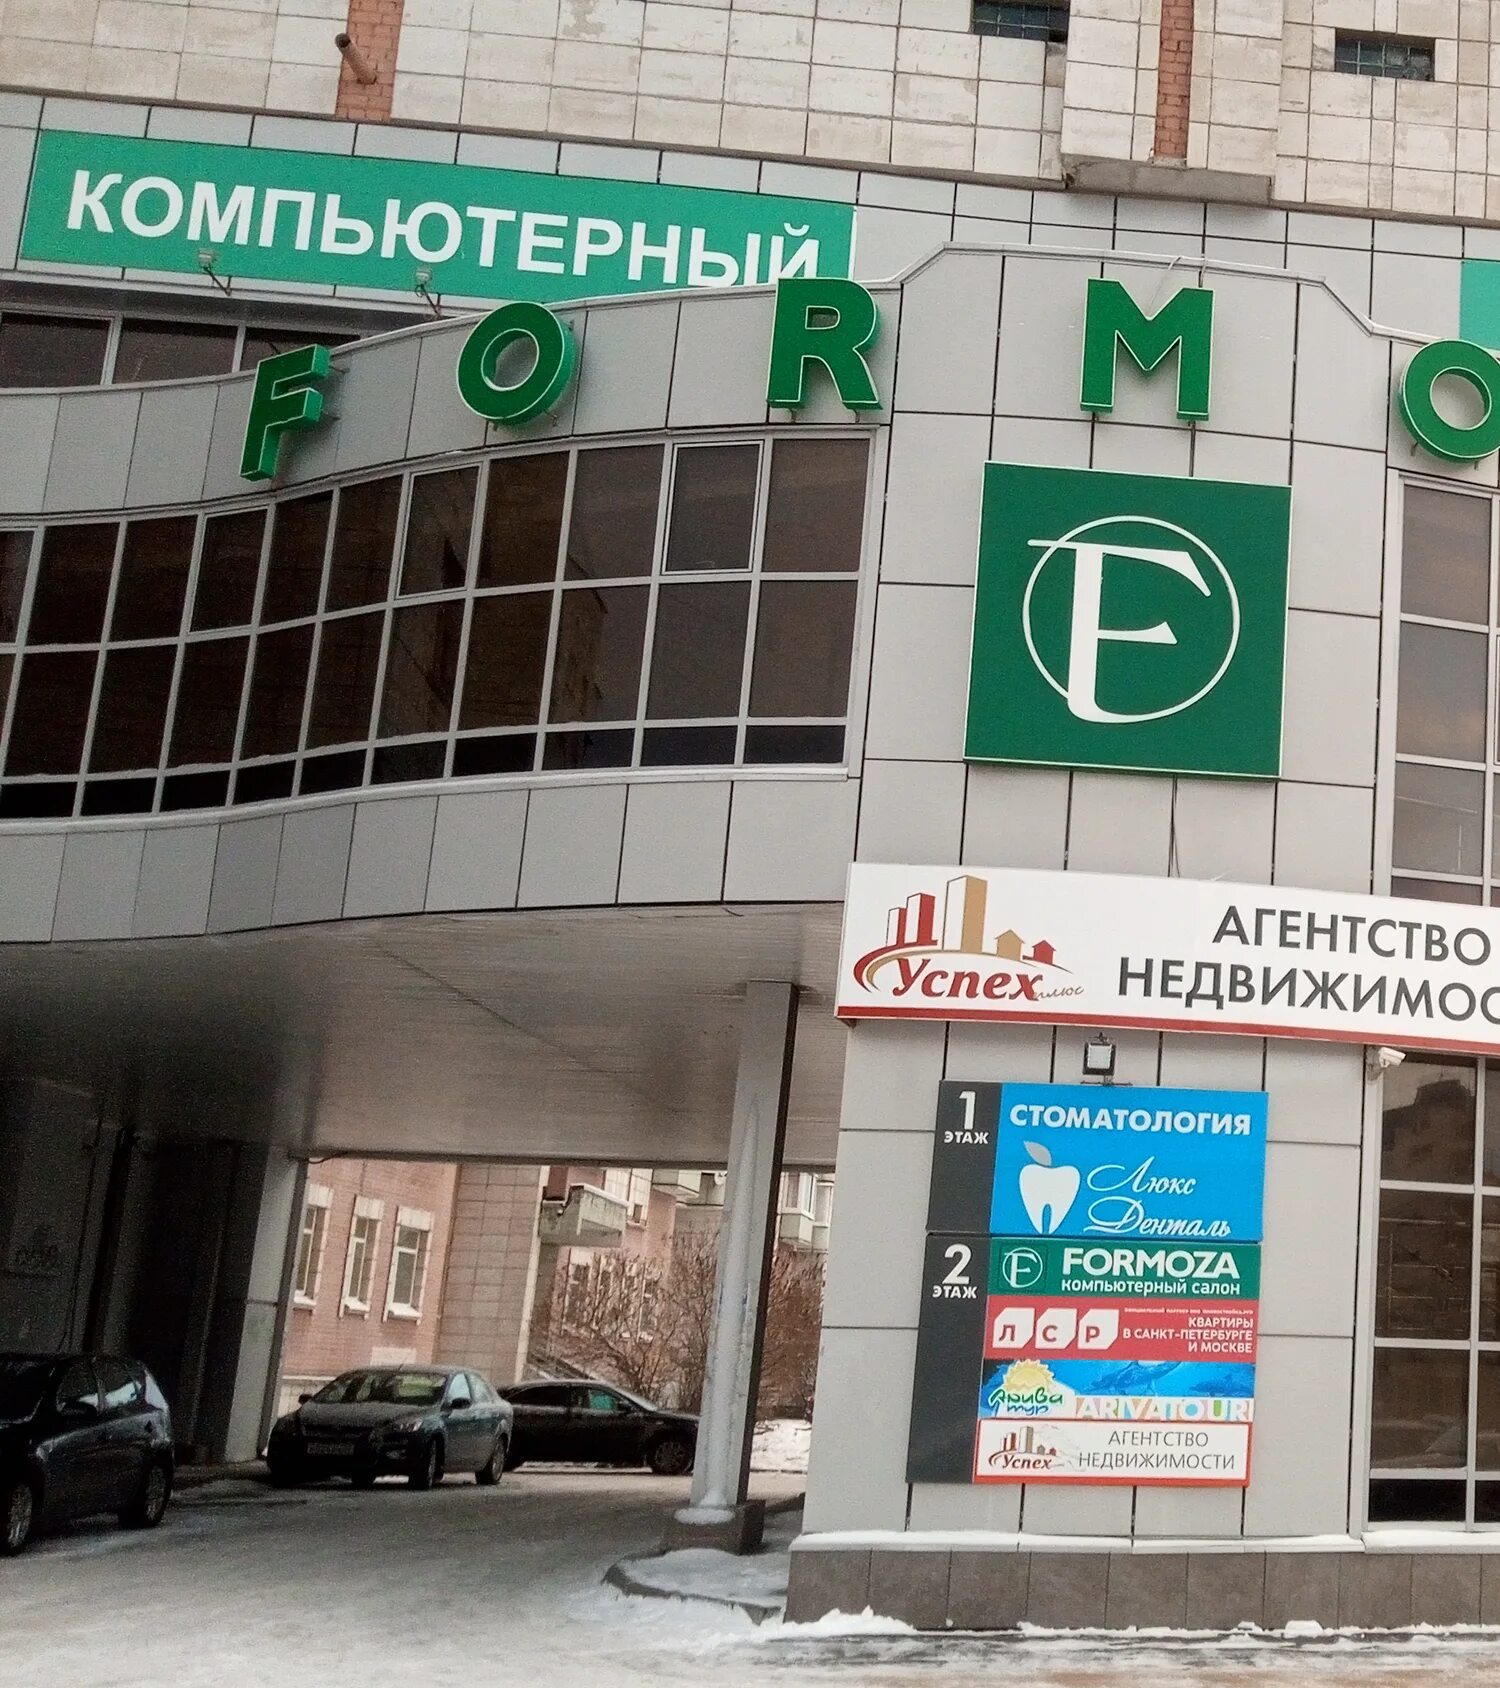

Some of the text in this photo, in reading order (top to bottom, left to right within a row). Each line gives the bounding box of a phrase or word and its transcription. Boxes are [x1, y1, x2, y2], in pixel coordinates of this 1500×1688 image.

[66, 168, 821, 287] КОМПЬЮТЕРНЫЙ
[1212, 905, 1492, 966] АГЕНТСТВО
[893, 958, 1043, 1001] Успех
[959, 1091, 976, 1130] 1
[1010, 1104, 1251, 1136] СТОМАТОЛОГИЯ
[944, 1131, 989, 1145] ЭТАЖ
[1087, 1157, 1196, 1195] Люкс
[1083, 1196, 1231, 1237] Денталь
[943, 1244, 972, 1284] 2
[1062, 1248, 1240, 1279] FORMOZA
[932, 1285, 977, 1299] ЭТАЖ
[1061, 1278, 1240, 1297] компьютерный салон
[1123, 1328, 1253, 1341] В САНКТ-ПЕТЕРБУРГЕ
[1188, 1317, 1254, 1329] КВАРТИРЫ
[1188, 1342, 1253, 1353] И МОСКВЕ
[1076, 1398, 1249, 1421] ARIVATOUR
[1108, 1430, 1209, 1447] АГЕНТСТВО
[1000, 1454, 1053, 1470] Успех
[1078, 1452, 1235, 1470] НЕДВИЖИМОСТИ
